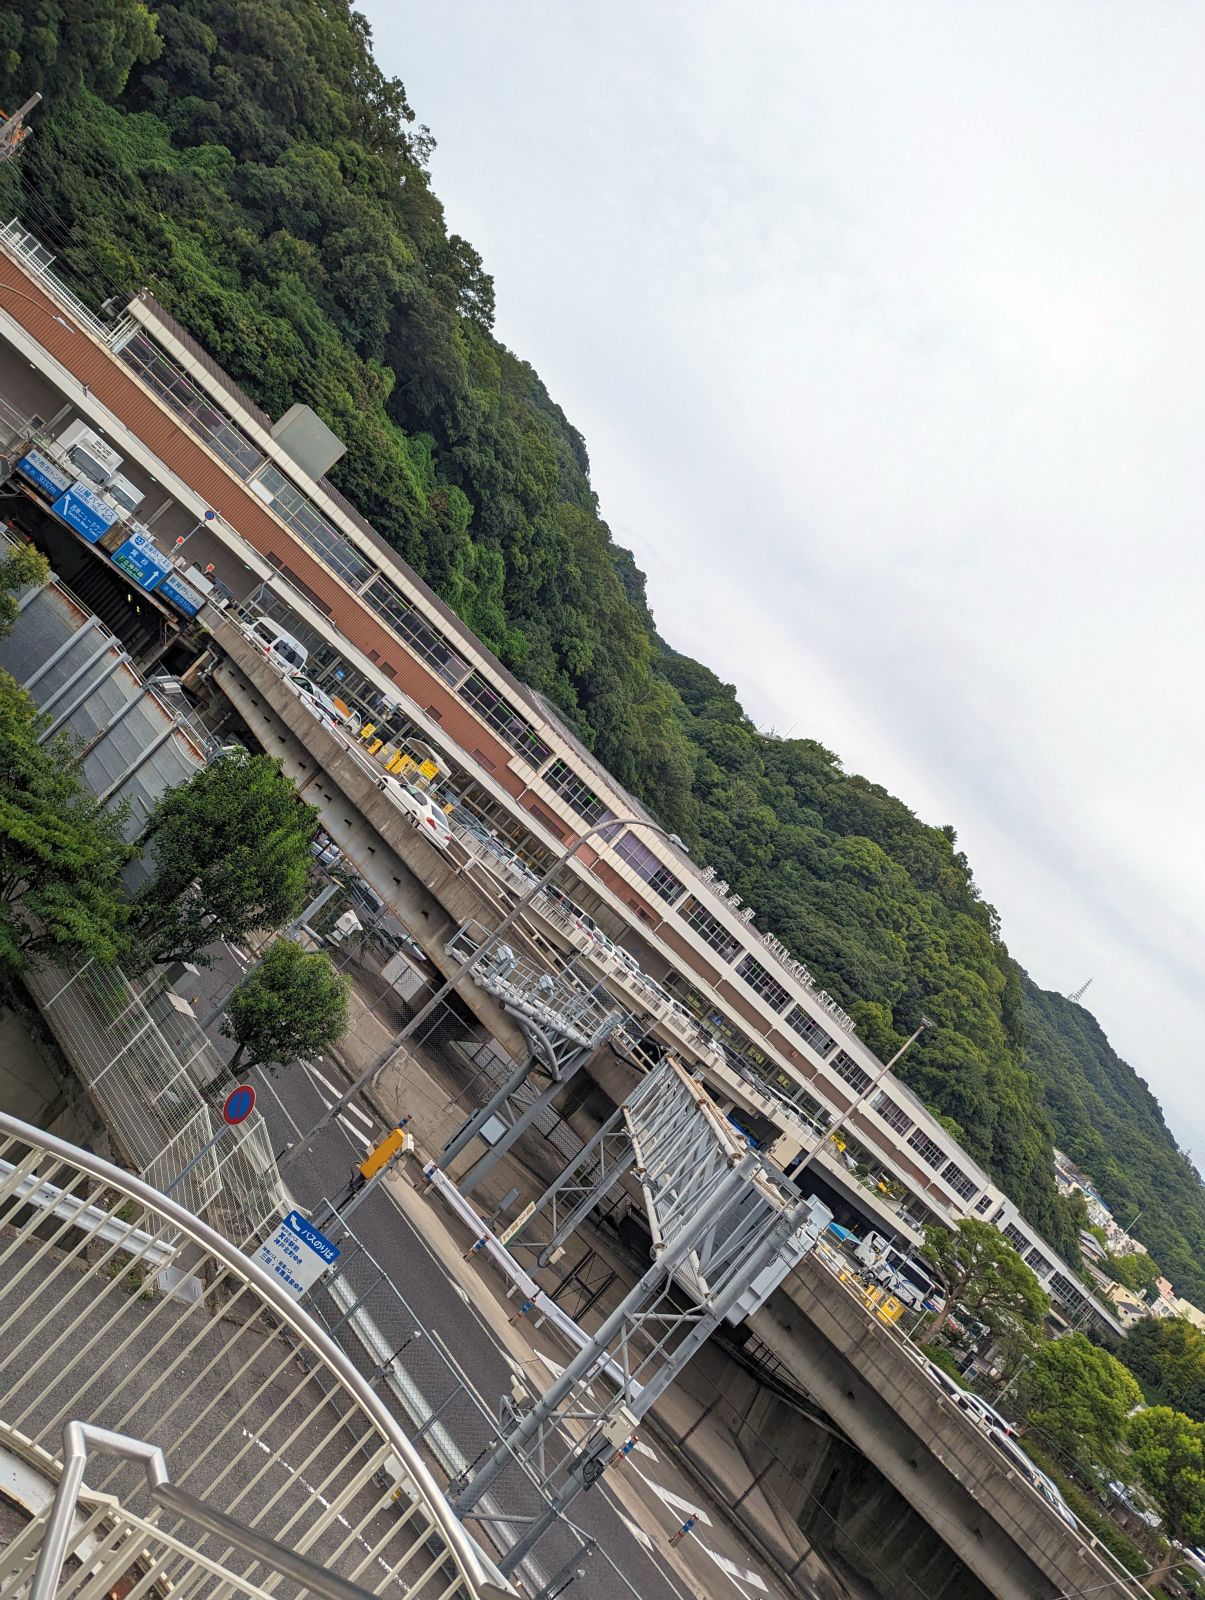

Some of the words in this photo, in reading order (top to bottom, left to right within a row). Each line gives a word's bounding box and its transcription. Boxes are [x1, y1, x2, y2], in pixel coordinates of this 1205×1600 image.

[76, 484, 115, 519] 山麓バイパス
[134, 536, 144, 545] 32
[168, 576, 202, 606] 新神戸トンネル
[701, 865, 755, 923] 新神戸駅
[816, 989, 856, 1033] STATION
[273, 1237, 303, 1265] 神戸北町ゆき
